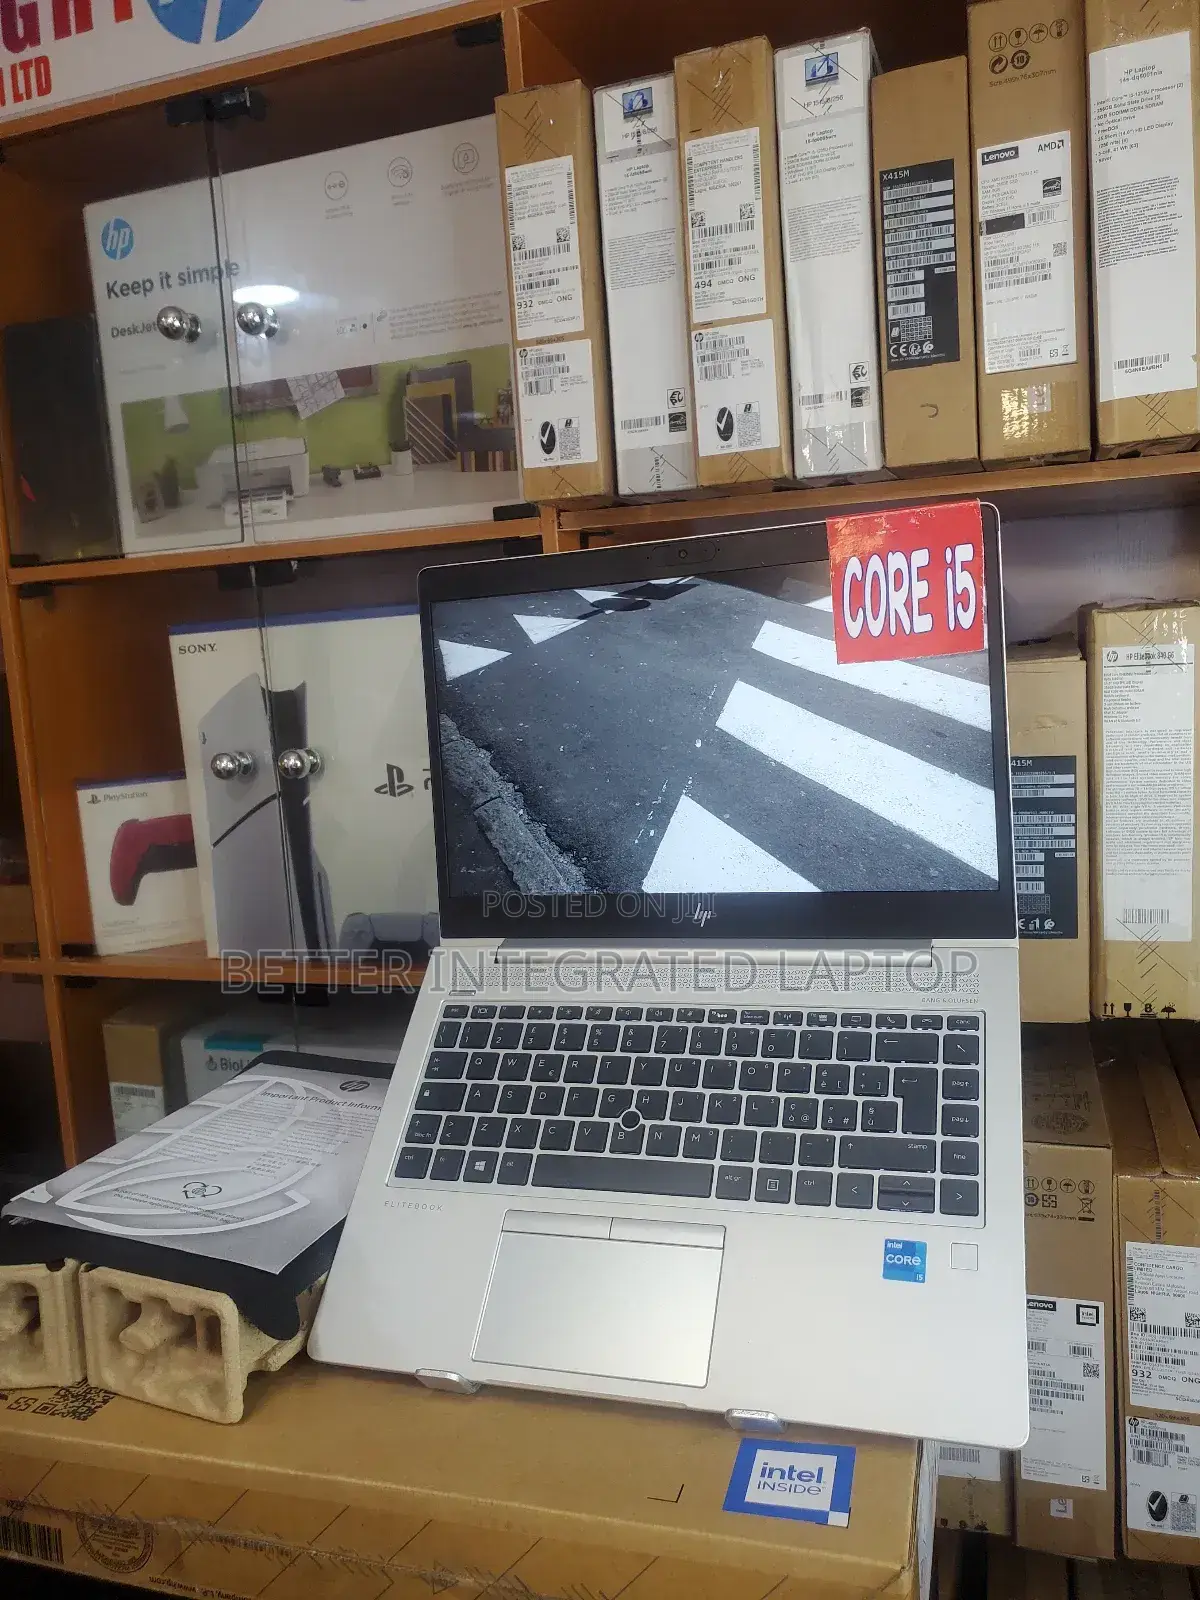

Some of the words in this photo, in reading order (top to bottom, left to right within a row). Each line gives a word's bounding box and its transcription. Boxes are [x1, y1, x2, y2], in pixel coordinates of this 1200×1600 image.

[1135, 65, 1156, 74] Laptop
[11, 55, 53, 104] LTD
[984, 149, 1016, 162] Lenovo
[1037, 141, 1057, 153] AMD
[882, 170, 910, 182] X415M
[103, 217, 134, 260] hp
[106, 277, 154, 301] Keep
[159, 270, 174, 290] it
[176, 259, 240, 288] simple
[694, 279, 712, 290] 494
[738, 274, 756, 283] ONG
[517, 299, 533, 310] 932
[556, 293, 573, 302] ONG
[842, 547, 933, 642] CORE
[944, 543, 977, 633] i5
[178, 643, 217, 659] SONY
[1011, 759, 1033, 770] 415M
[103, 792, 149, 804] PlayStation
[261, 1090, 310, 1104] Important
[309, 1096, 348, 1107] Product
[618, 1131, 626, 1139] B
[692, 1134, 700, 1142] M
[887, 1240, 903, 1250] intel
[916, 1273, 924, 1281] i5
[1131, 1368, 1152, 1379] 932
[1181, 1376, 1200, 1384] ONG
[760, 1461, 824, 1484] intel
